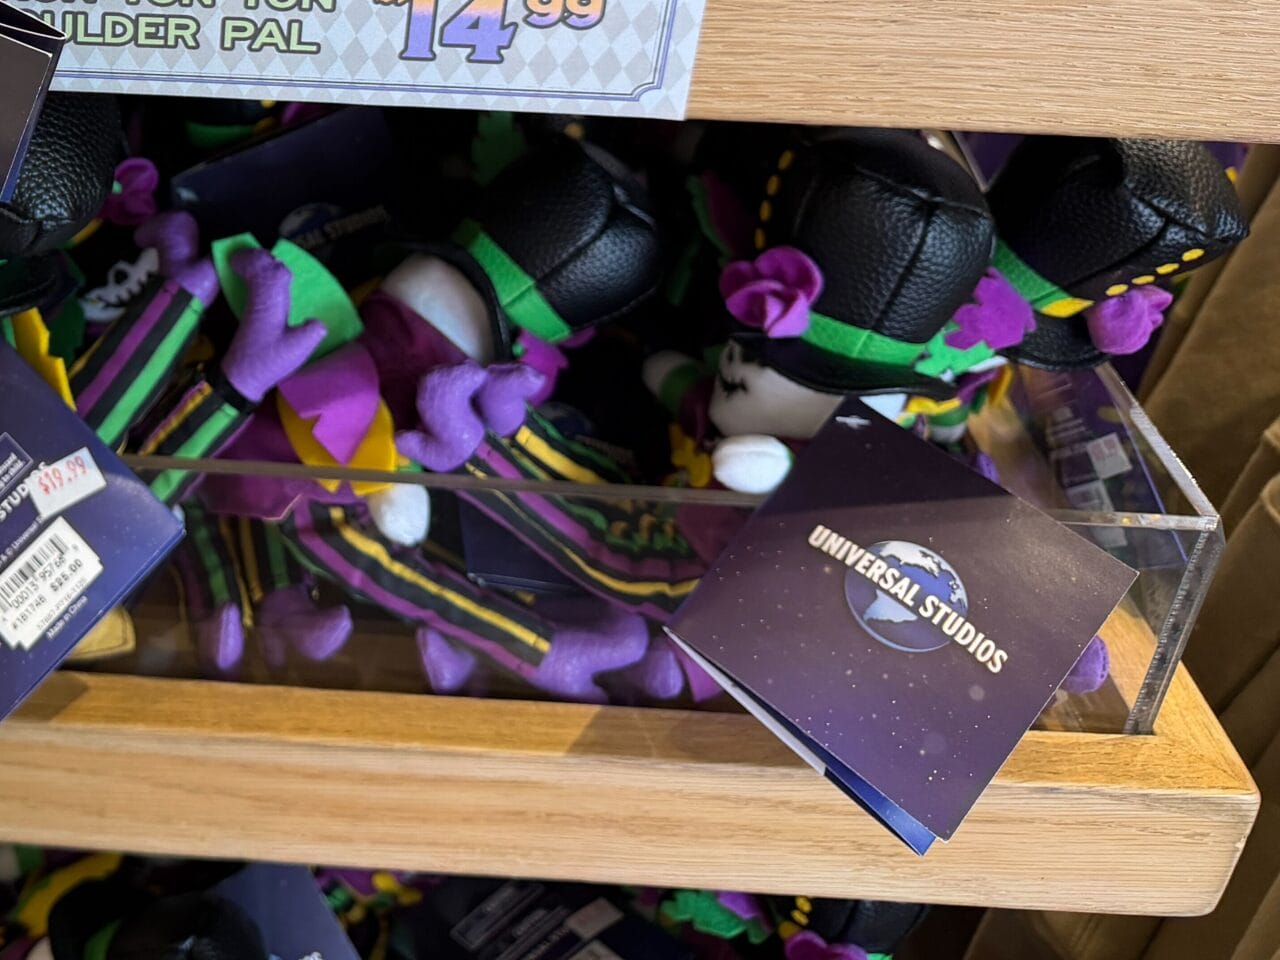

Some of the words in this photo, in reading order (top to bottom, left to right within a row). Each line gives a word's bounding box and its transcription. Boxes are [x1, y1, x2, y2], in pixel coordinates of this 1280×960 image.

[220, 14, 321, 54] PAL
[38, 455, 88, 495] $19.99
[808, 524, 921, 607] UNIVERSAL
[918, 595, 1009, 674] STUDIOS
